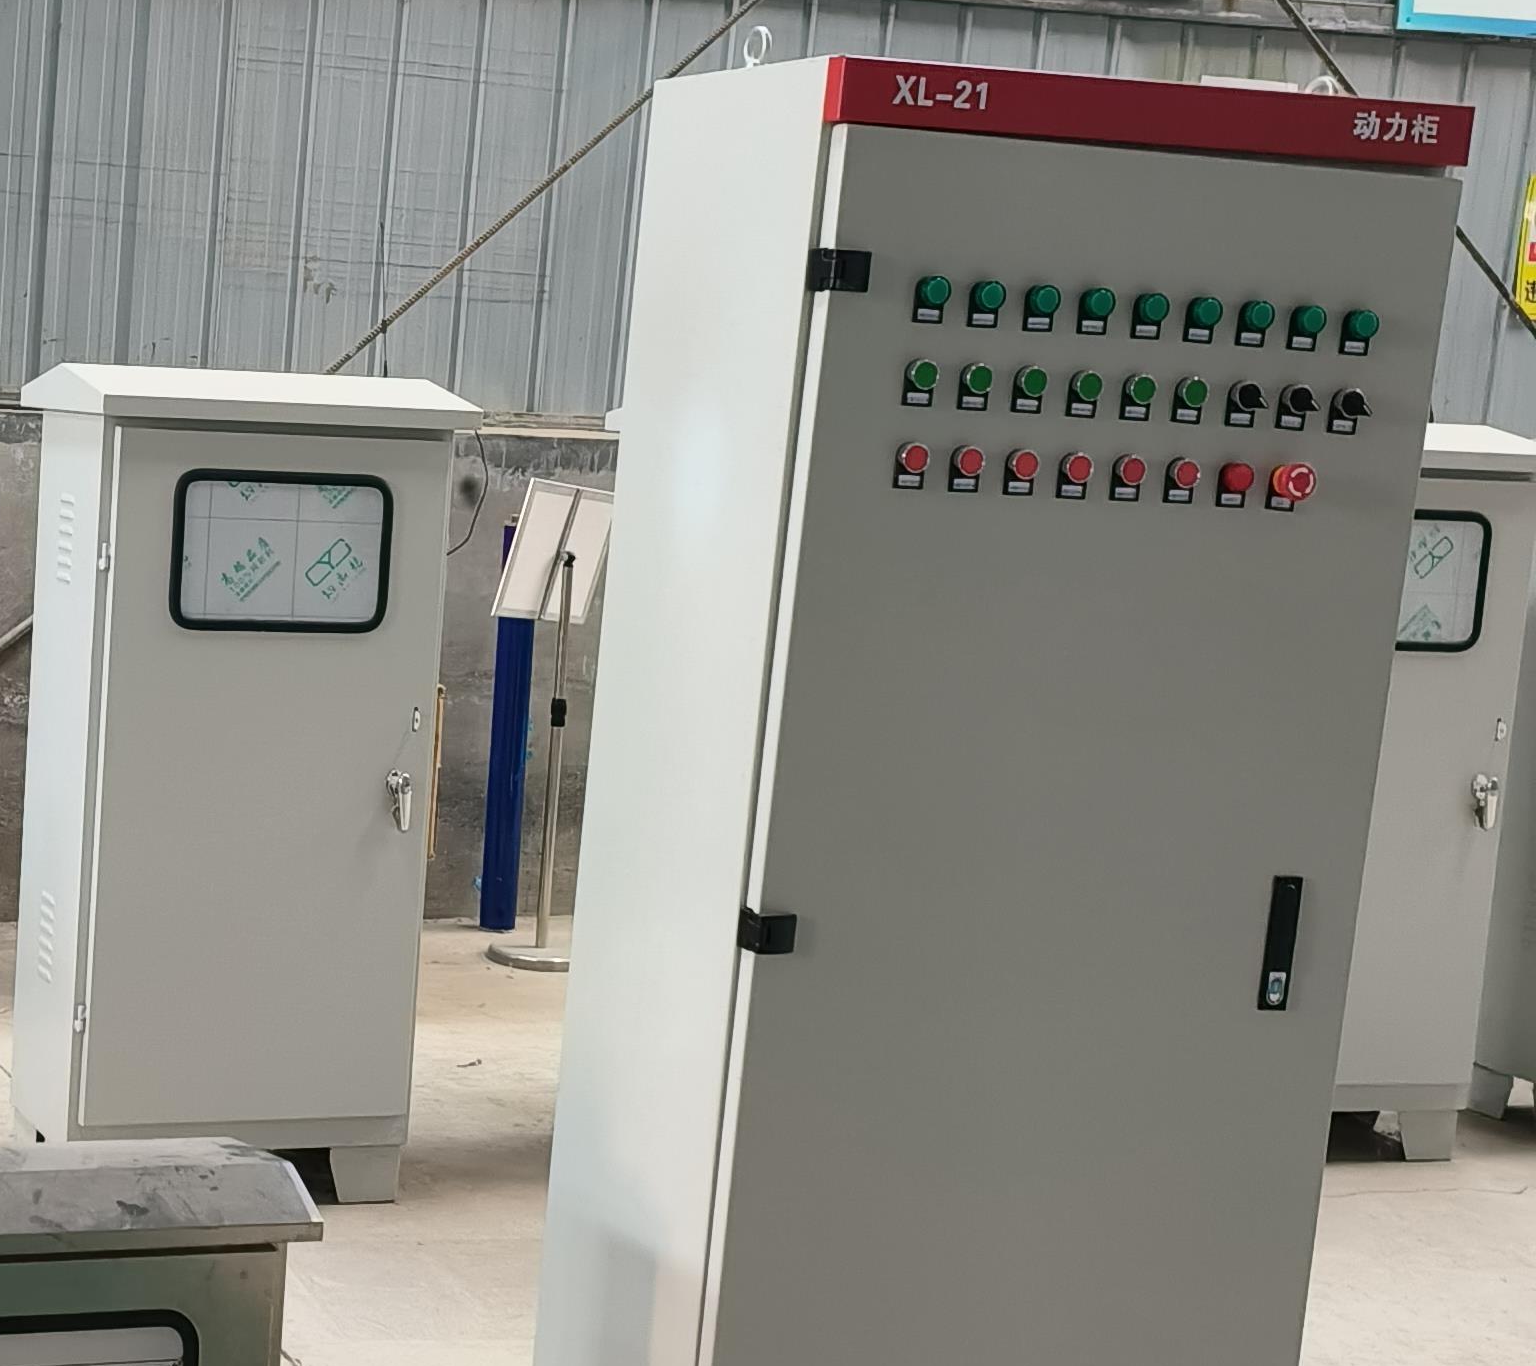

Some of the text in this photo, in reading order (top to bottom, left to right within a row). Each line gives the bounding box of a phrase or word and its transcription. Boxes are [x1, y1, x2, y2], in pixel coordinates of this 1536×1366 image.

[892, 74, 989, 110] XL-21
[1352, 110, 1440, 144] 动力柜
